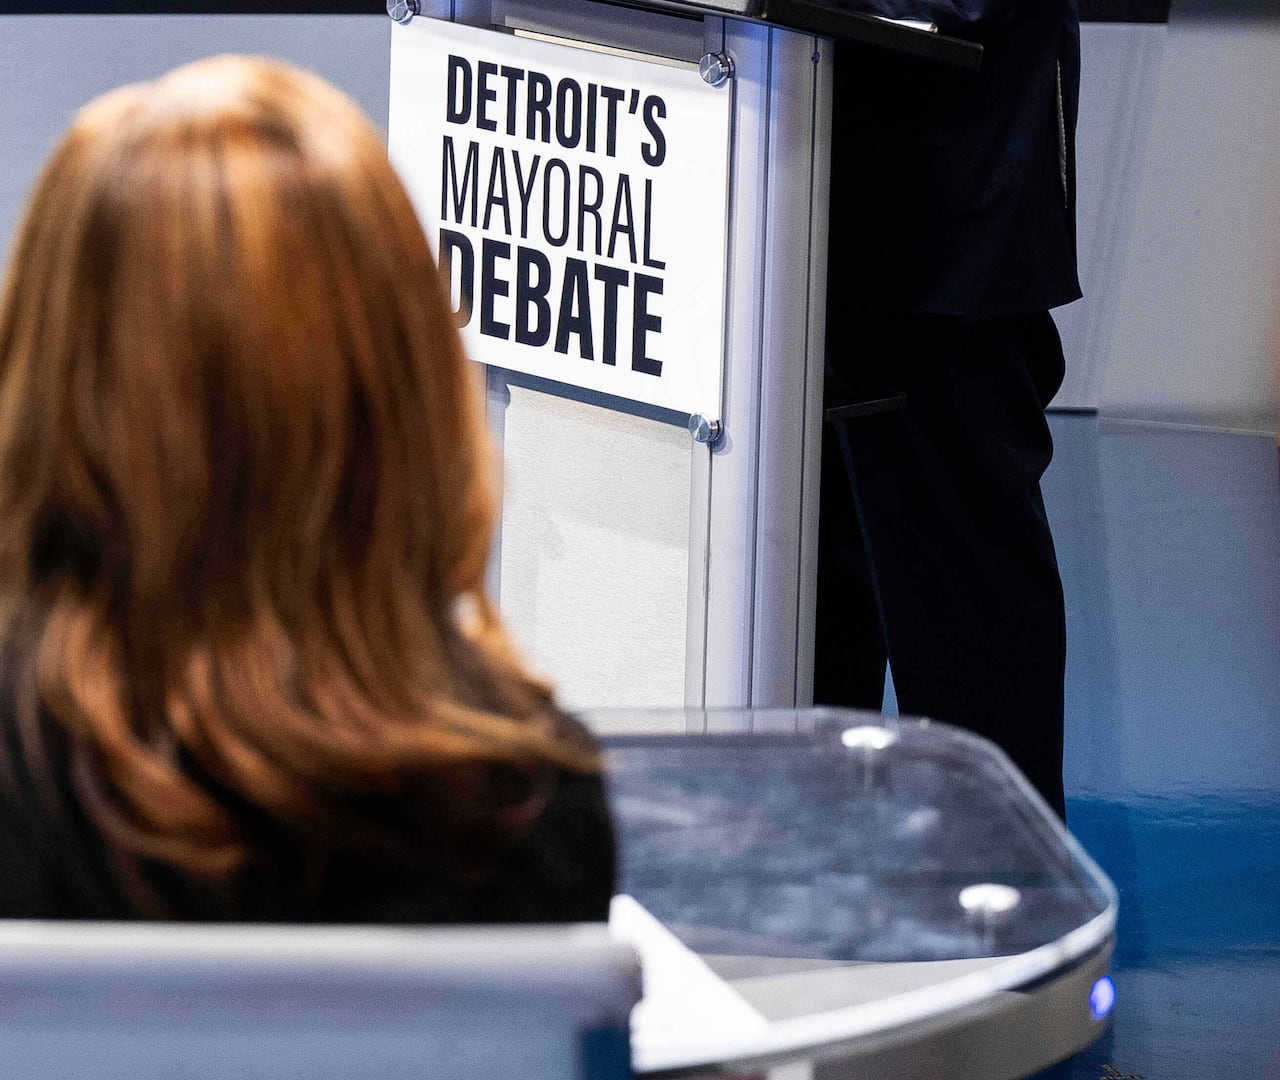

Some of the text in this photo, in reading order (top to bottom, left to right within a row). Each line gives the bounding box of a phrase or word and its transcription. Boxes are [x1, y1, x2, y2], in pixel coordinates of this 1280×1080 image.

[446, 53, 668, 168] DETROIT'S
[441, 134, 667, 271] MAYORAL
[440, 228, 665, 378] DEBATE
